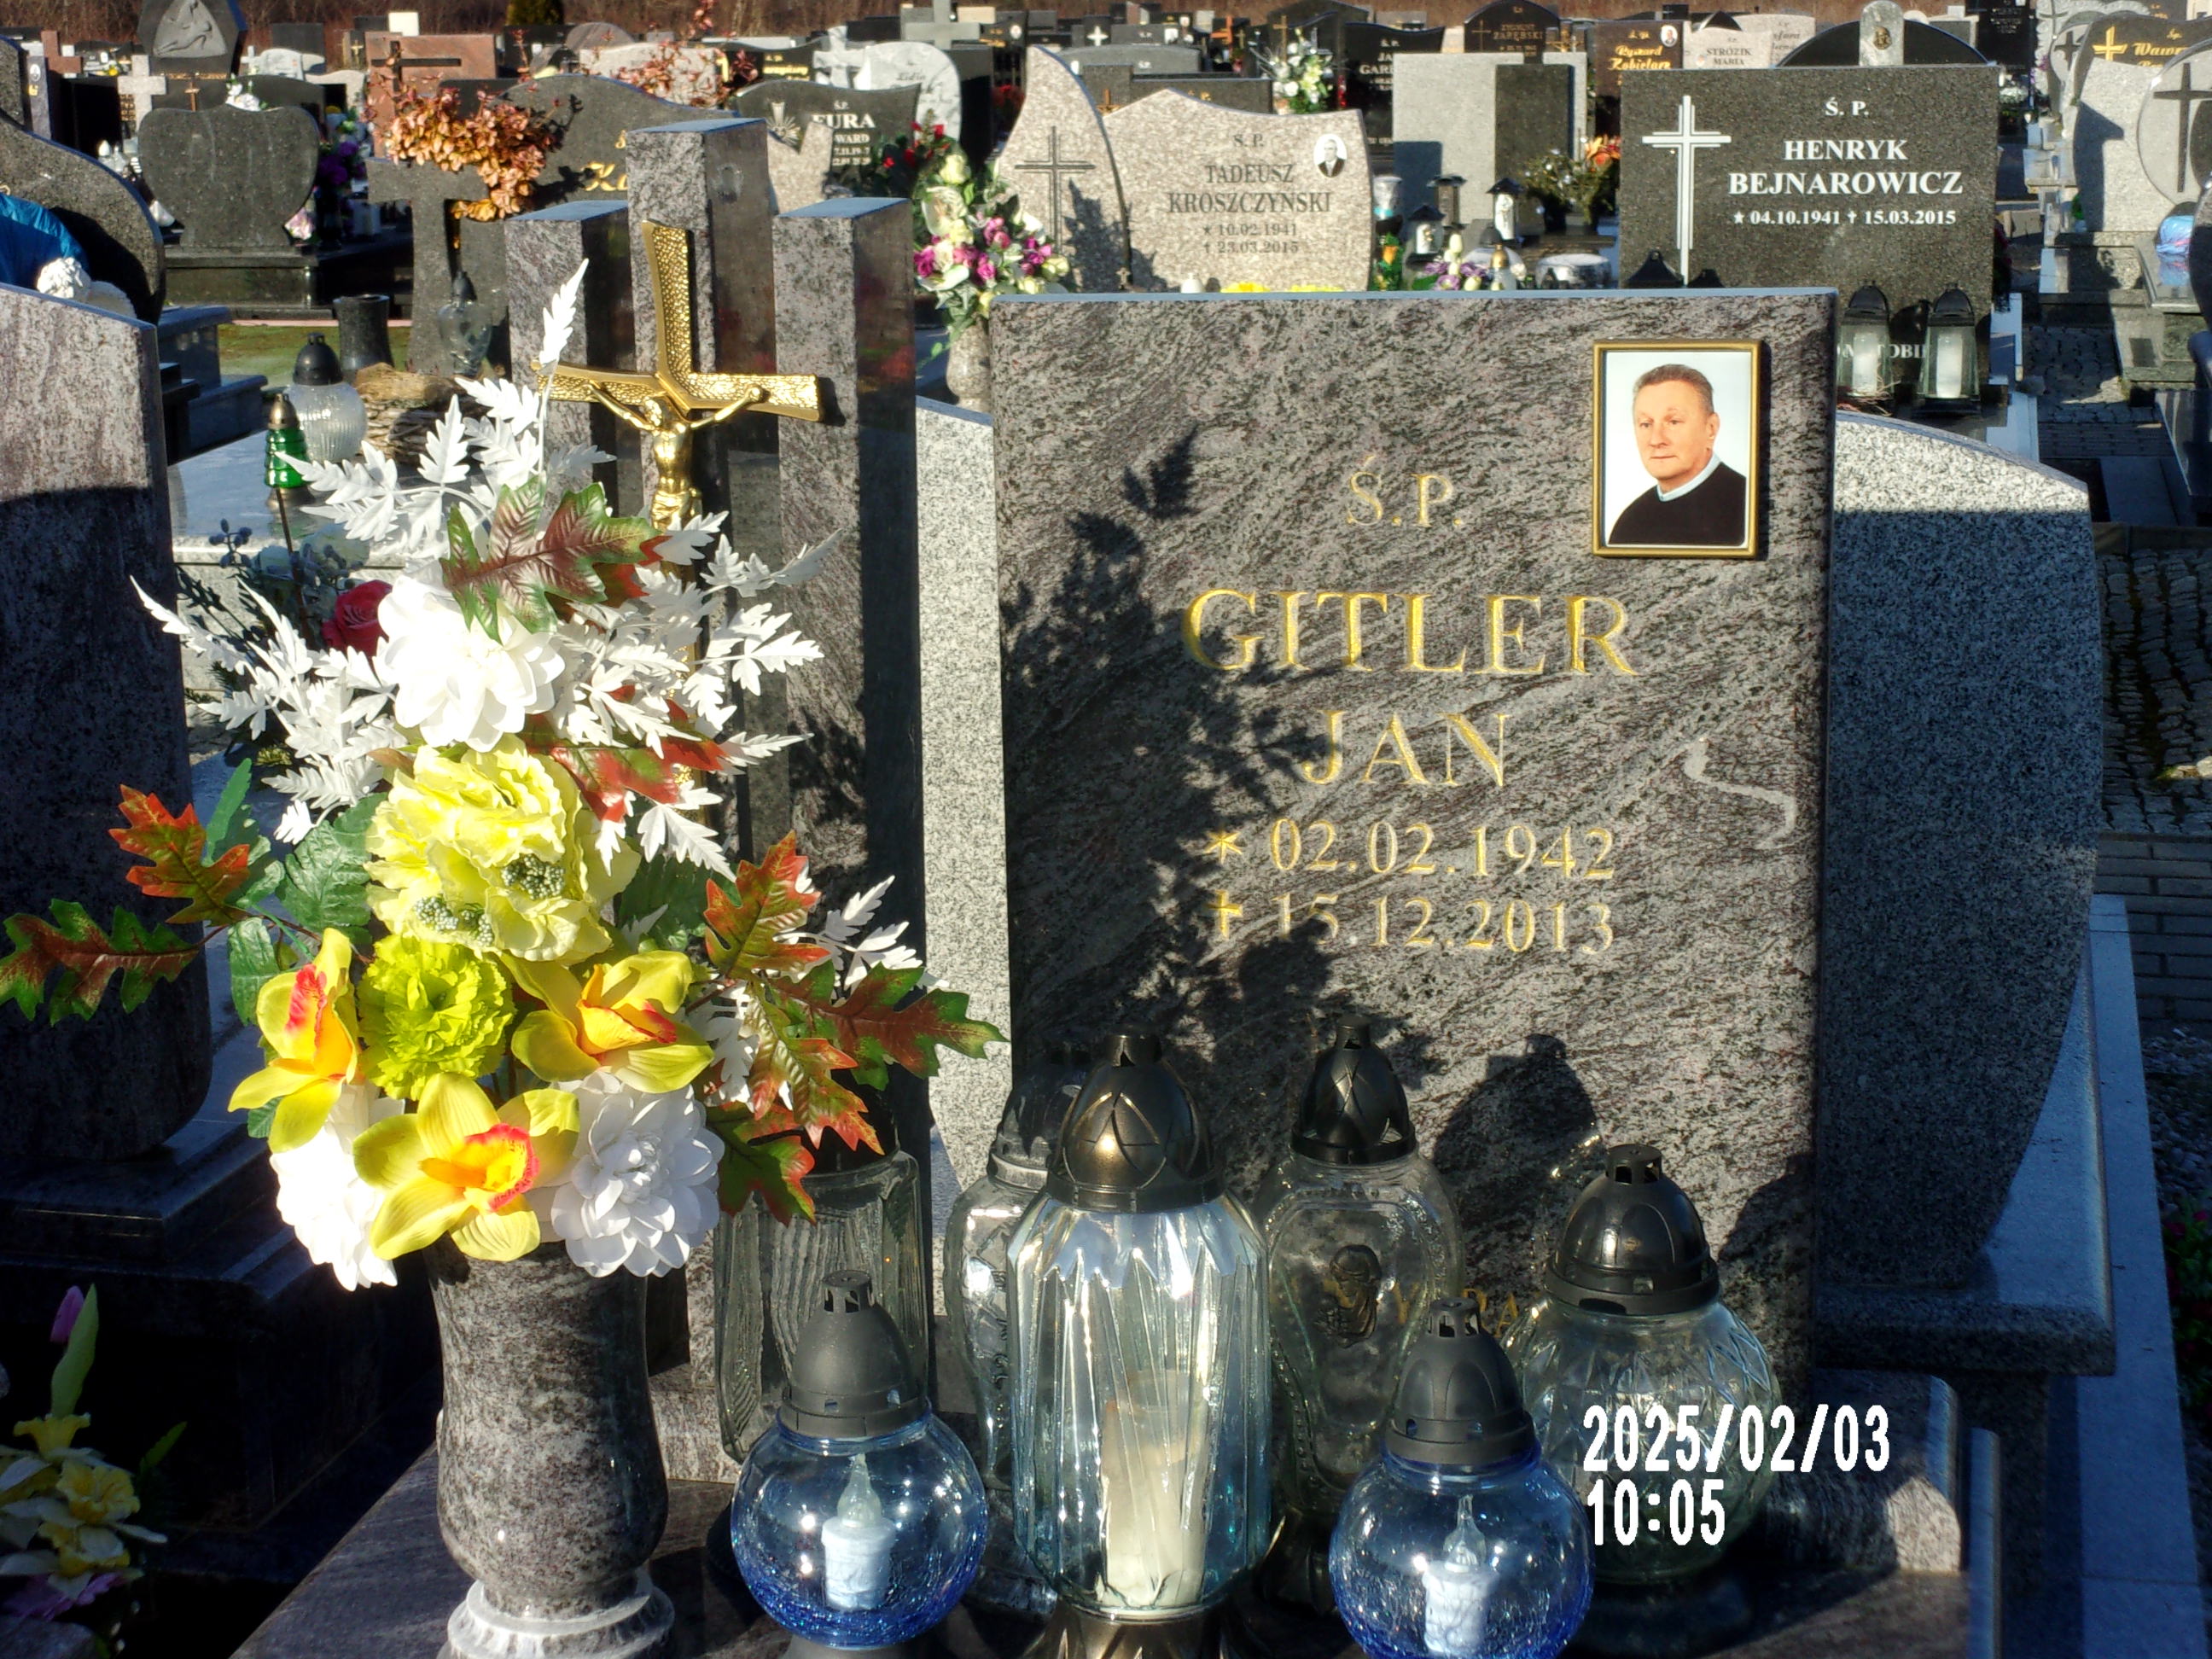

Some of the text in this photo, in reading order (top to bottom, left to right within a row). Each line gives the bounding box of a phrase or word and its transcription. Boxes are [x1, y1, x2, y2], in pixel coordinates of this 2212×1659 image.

[1377, 52, 1393, 61] JA
[1851, 101, 1869, 116] P.
[834, 134, 870, 143] WARD
[1784, 139, 1908, 160] HENRYK
[1204, 164, 1295, 183] TADEUSZ
[1728, 172, 1964, 195] BEJNAROWICZ
[1749, 210, 1957, 224] 04.10.1941 15.03.2015
[1182, 587, 1639, 676] GITLER
[1301, 709, 1511, 788] JAN
[1269, 818, 1615, 880] 02.02.1942
[1271, 893, 1615, 955] 15.12.2013
